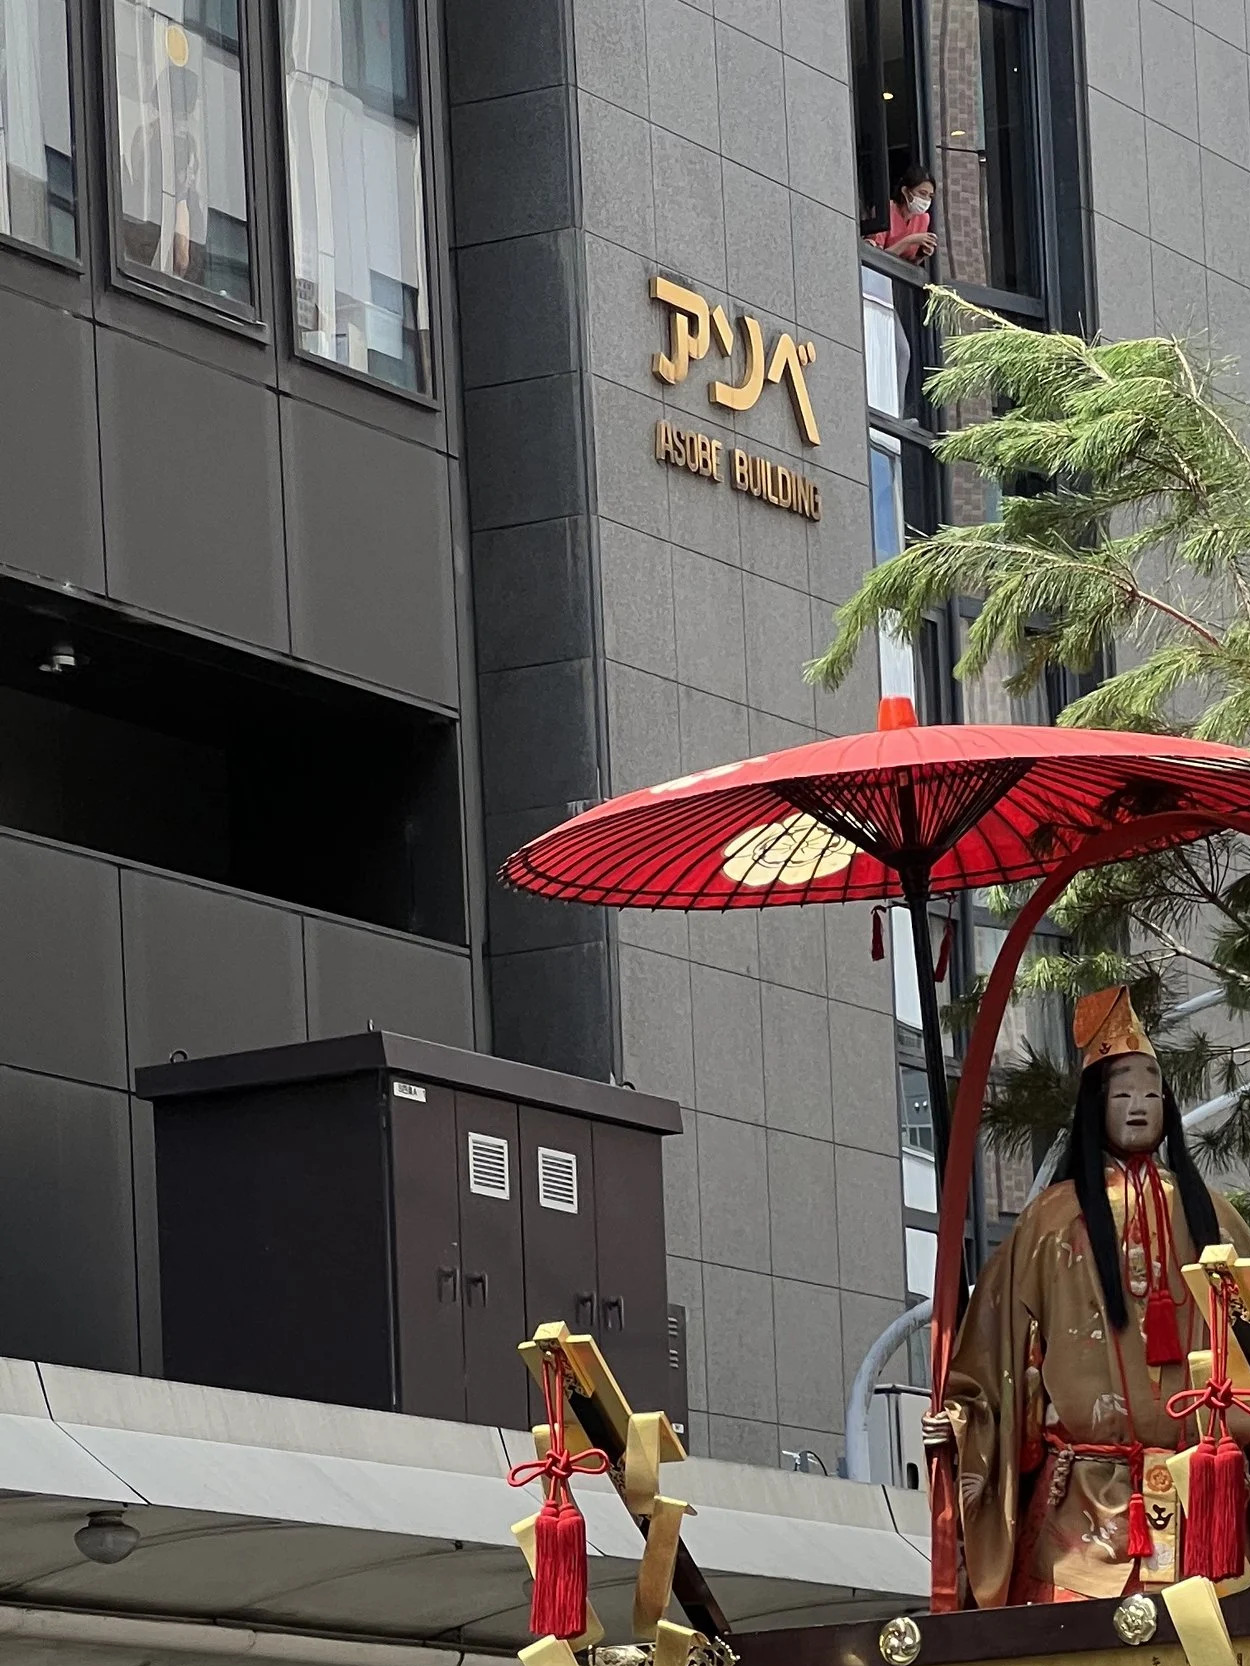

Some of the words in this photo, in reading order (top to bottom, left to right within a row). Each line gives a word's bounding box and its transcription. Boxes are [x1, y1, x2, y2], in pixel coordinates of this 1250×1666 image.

[649, 276, 821, 446] アソベ
[655, 419, 724, 483] ASOBE
[730, 448, 822, 521] BUILDING
